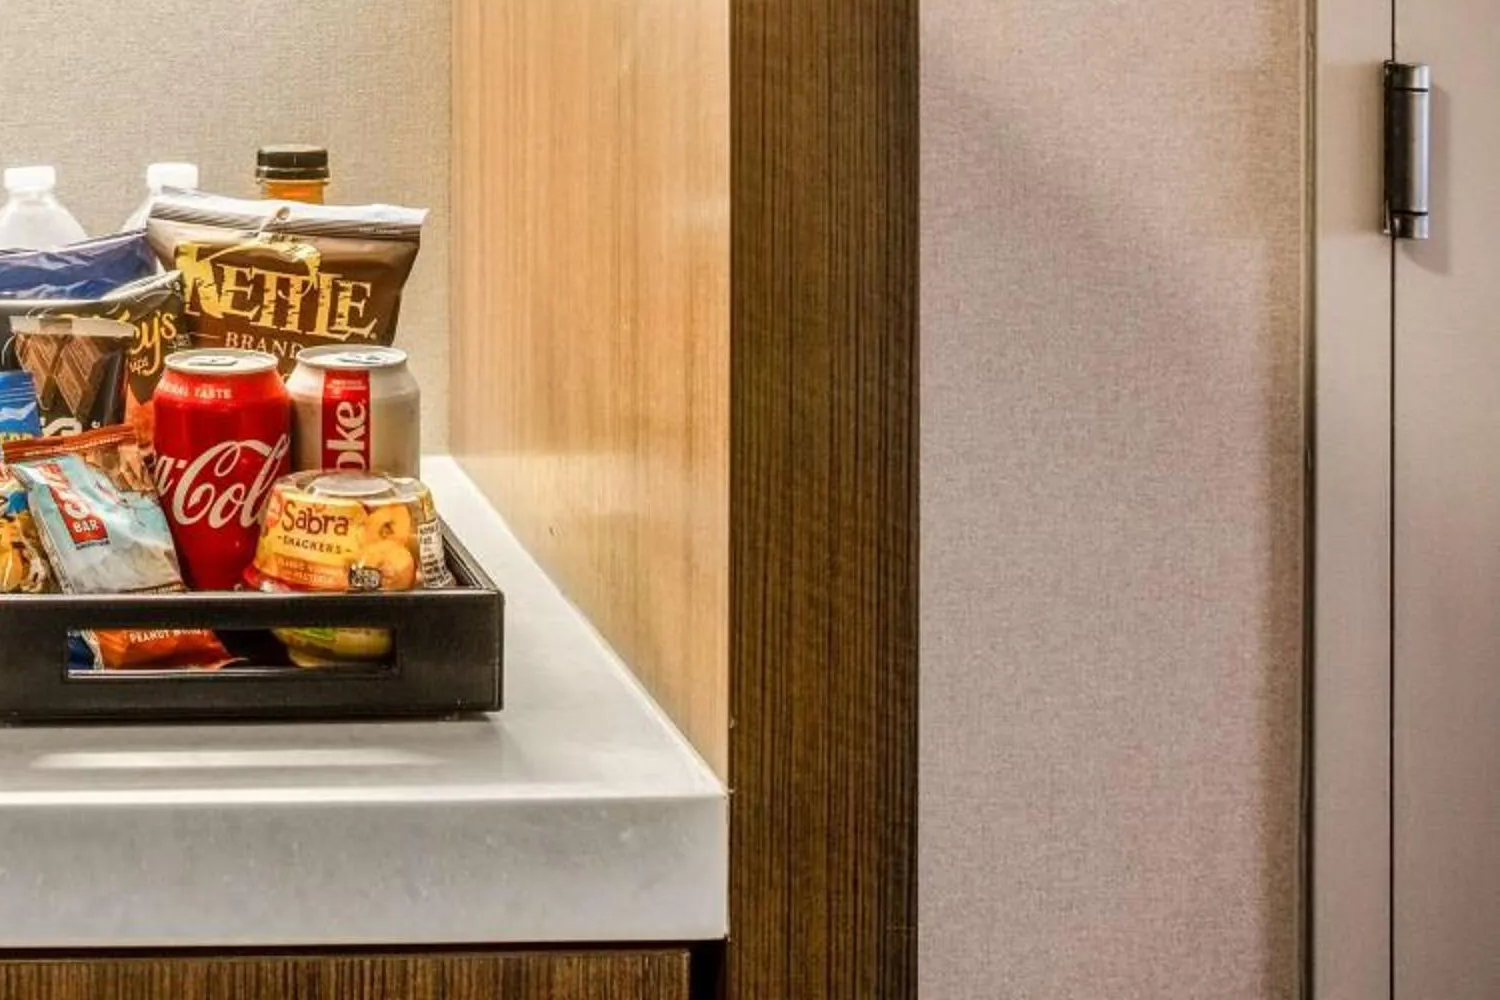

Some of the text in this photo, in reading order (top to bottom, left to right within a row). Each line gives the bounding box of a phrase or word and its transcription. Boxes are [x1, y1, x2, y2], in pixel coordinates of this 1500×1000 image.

[175, 240, 378, 341] KETTLE
[225, 330, 303, 360] BRAND
[194, 384, 232, 399] TASTE
[326, 400, 366, 471] oke
[72, 519, 100, 533] BAR
[281, 500, 350, 537] Sabra
